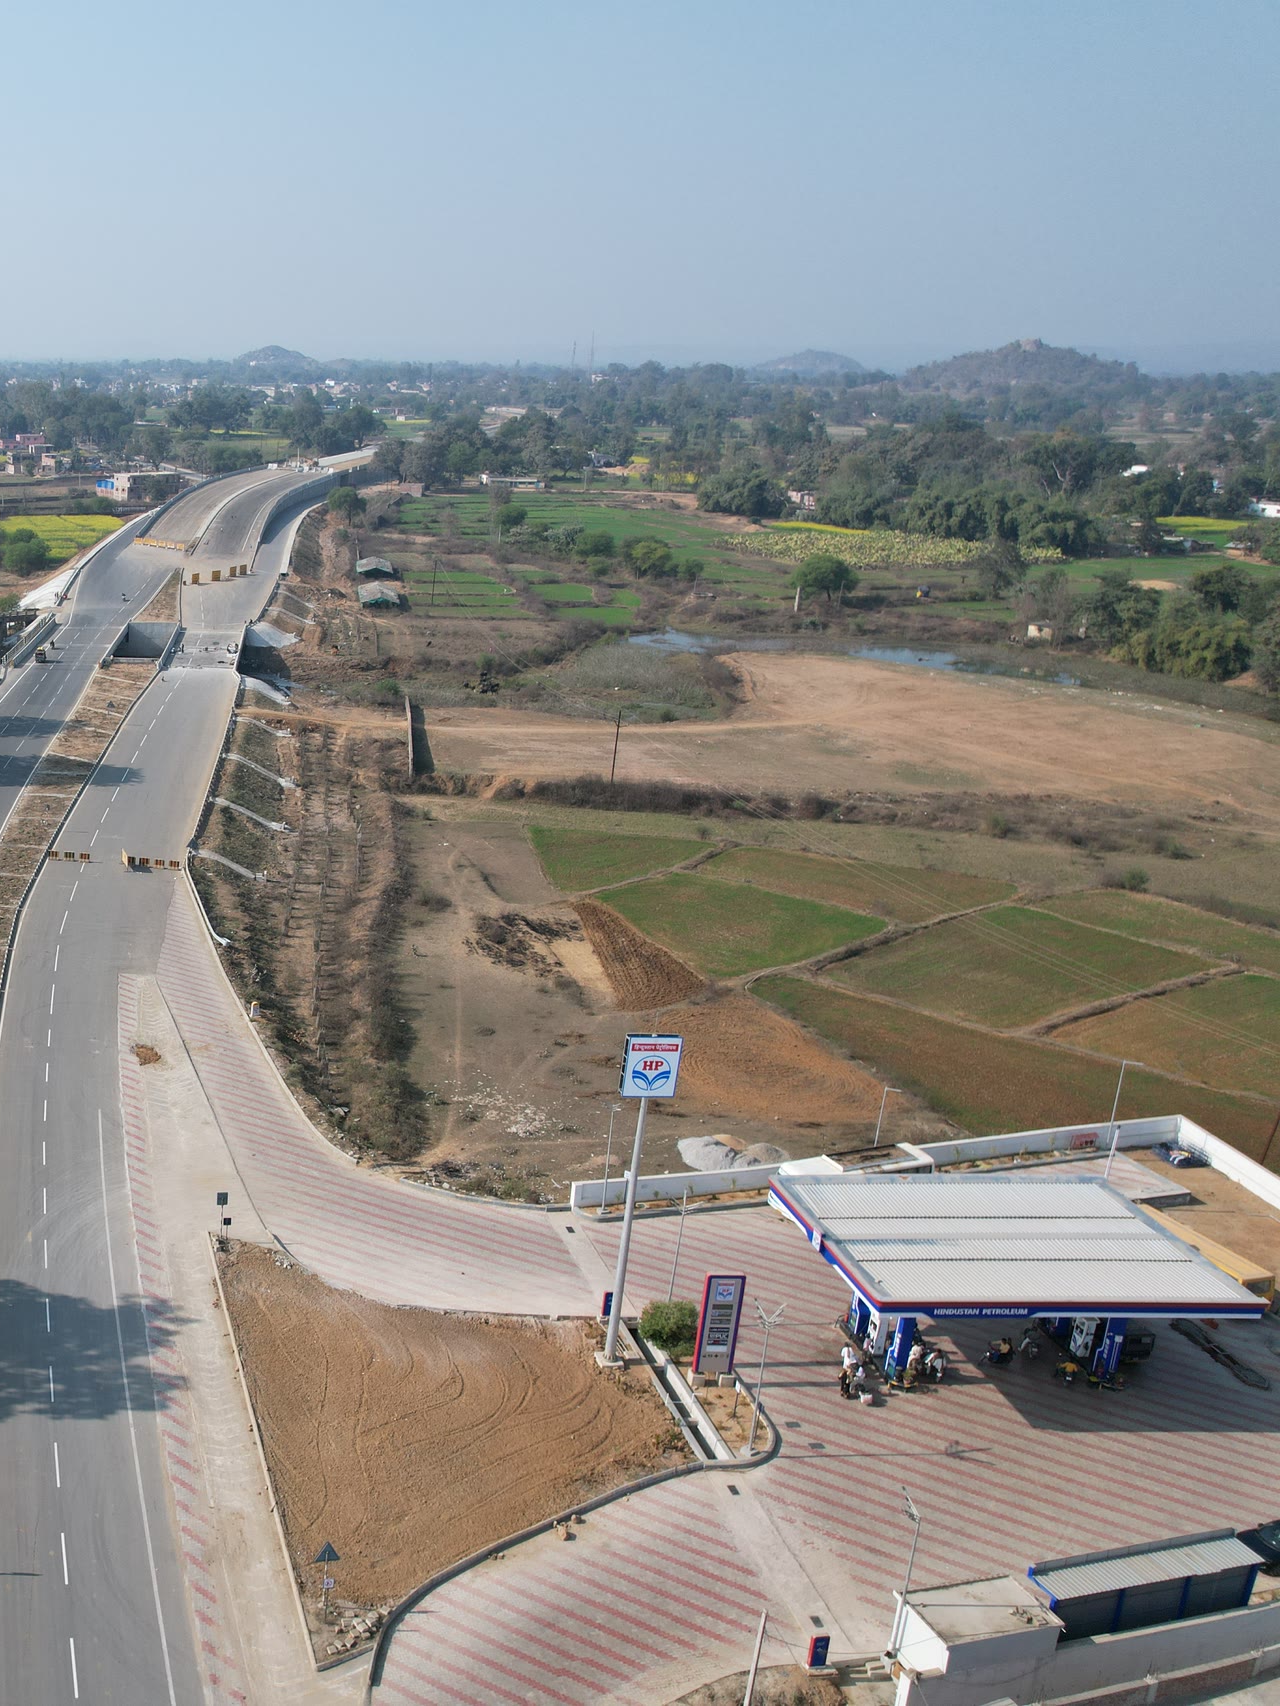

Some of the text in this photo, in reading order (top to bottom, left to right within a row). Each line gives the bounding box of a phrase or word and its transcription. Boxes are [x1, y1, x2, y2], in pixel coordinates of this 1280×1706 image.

[642, 1060, 664, 1071] HP
[933, 1308, 1028, 1316] HINDUSTAN PETROLEUM
